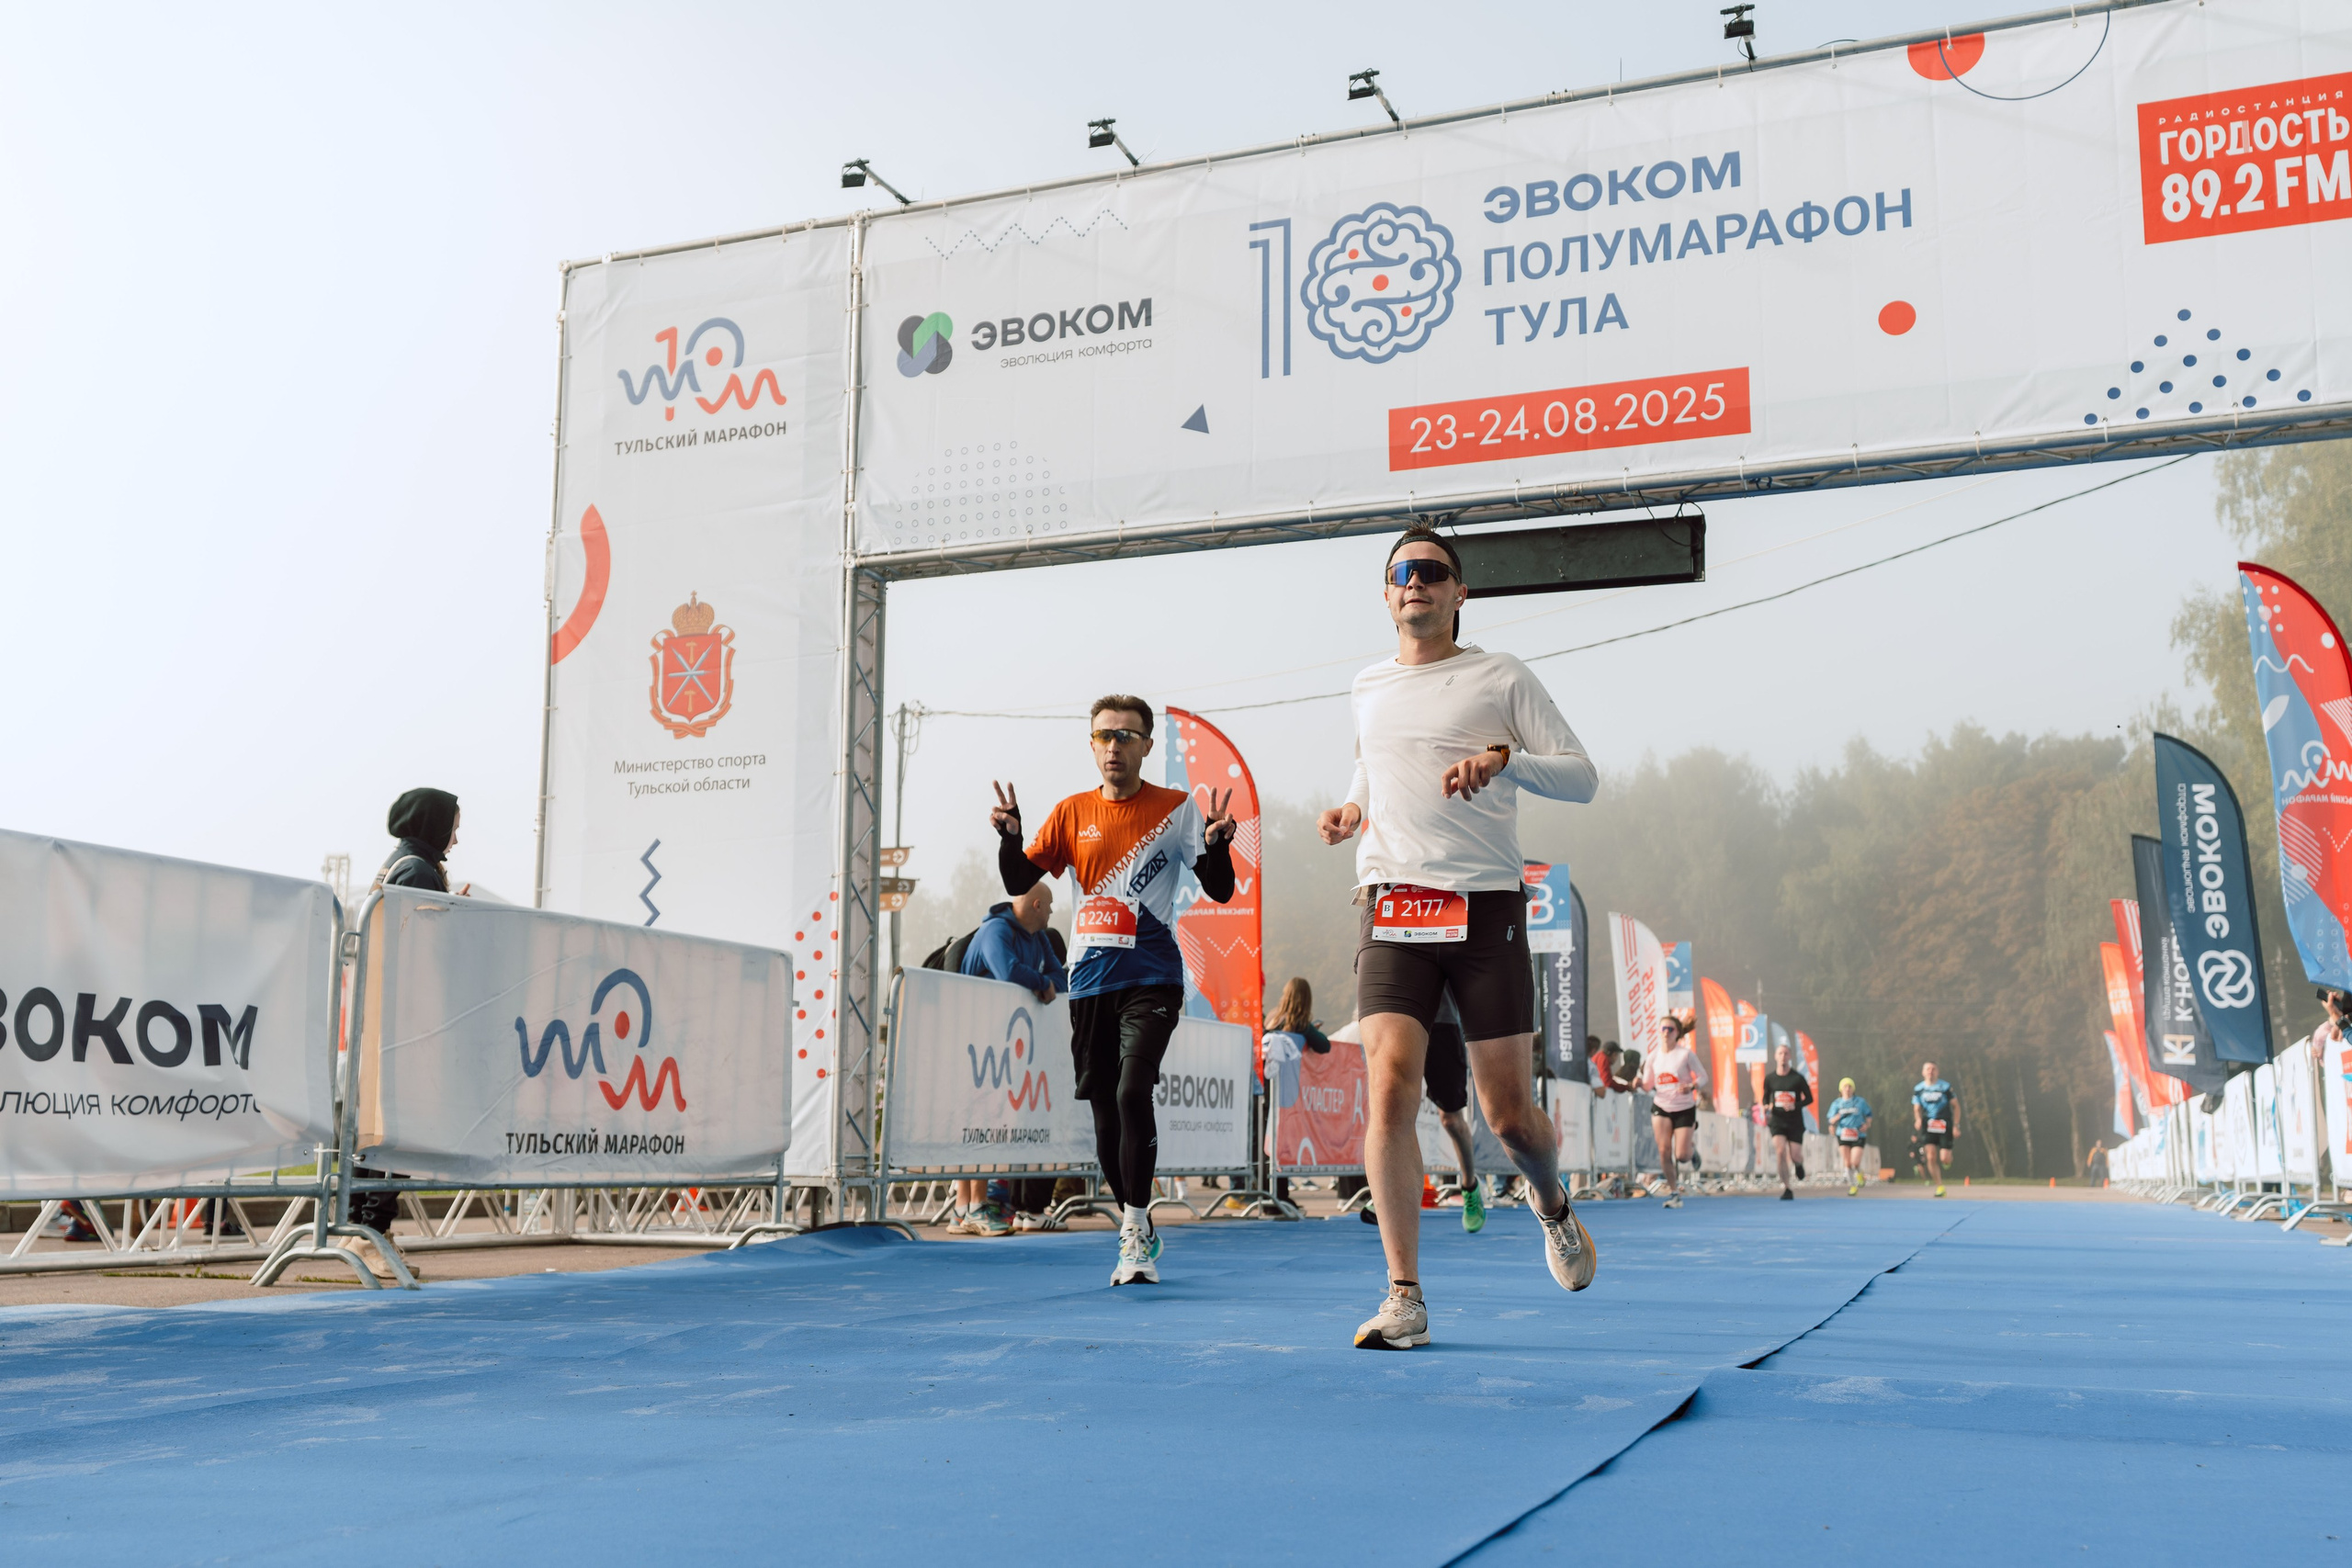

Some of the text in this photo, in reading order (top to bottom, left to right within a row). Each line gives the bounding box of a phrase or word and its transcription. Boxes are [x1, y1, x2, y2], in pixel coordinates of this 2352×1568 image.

[2159, 90, 2343, 125] РАДИОСТАНЦИЯ
[2159, 107, 2350, 165] ГОРДОСТЬ
[1484, 151, 1741, 224] ЭВОКОМ
[2162, 149, 2352, 222] 89.2 FM
[1484, 188, 1912, 286] ПОЛУМАРАФОН
[971, 297, 1153, 351] ЭВОКОМ
[1485, 292, 1629, 346] ТУЛА
[1000, 338, 1153, 369] эволюция комфорта
[1409, 381, 1725, 455] 23-24.08.2025
[615, 421, 787, 456] ТУЛЬСКИЙ МАРАФОН
[614, 752, 766, 774] Министерство спорта
[627, 775, 751, 798] Тульской области
[1091, 817, 1173, 896] ОЛУМАРАФОН
[1088, 910, 1119, 926] 2241
[1400, 898, 1444, 917] 2177
[0, 987, 258, 1070] ОКОМ
[1741, 1024, 1758, 1048] D
[1156, 1072, 1234, 1110] ЭВОКОМ
[1302, 1086, 1344, 1112] КЛАСТЕР
[505, 1128, 684, 1156] ТУЛЬСКИЙ МАРАФОН
[962, 1124, 1050, 1144] ТУЛЬСКИЙ МАРАФОН
